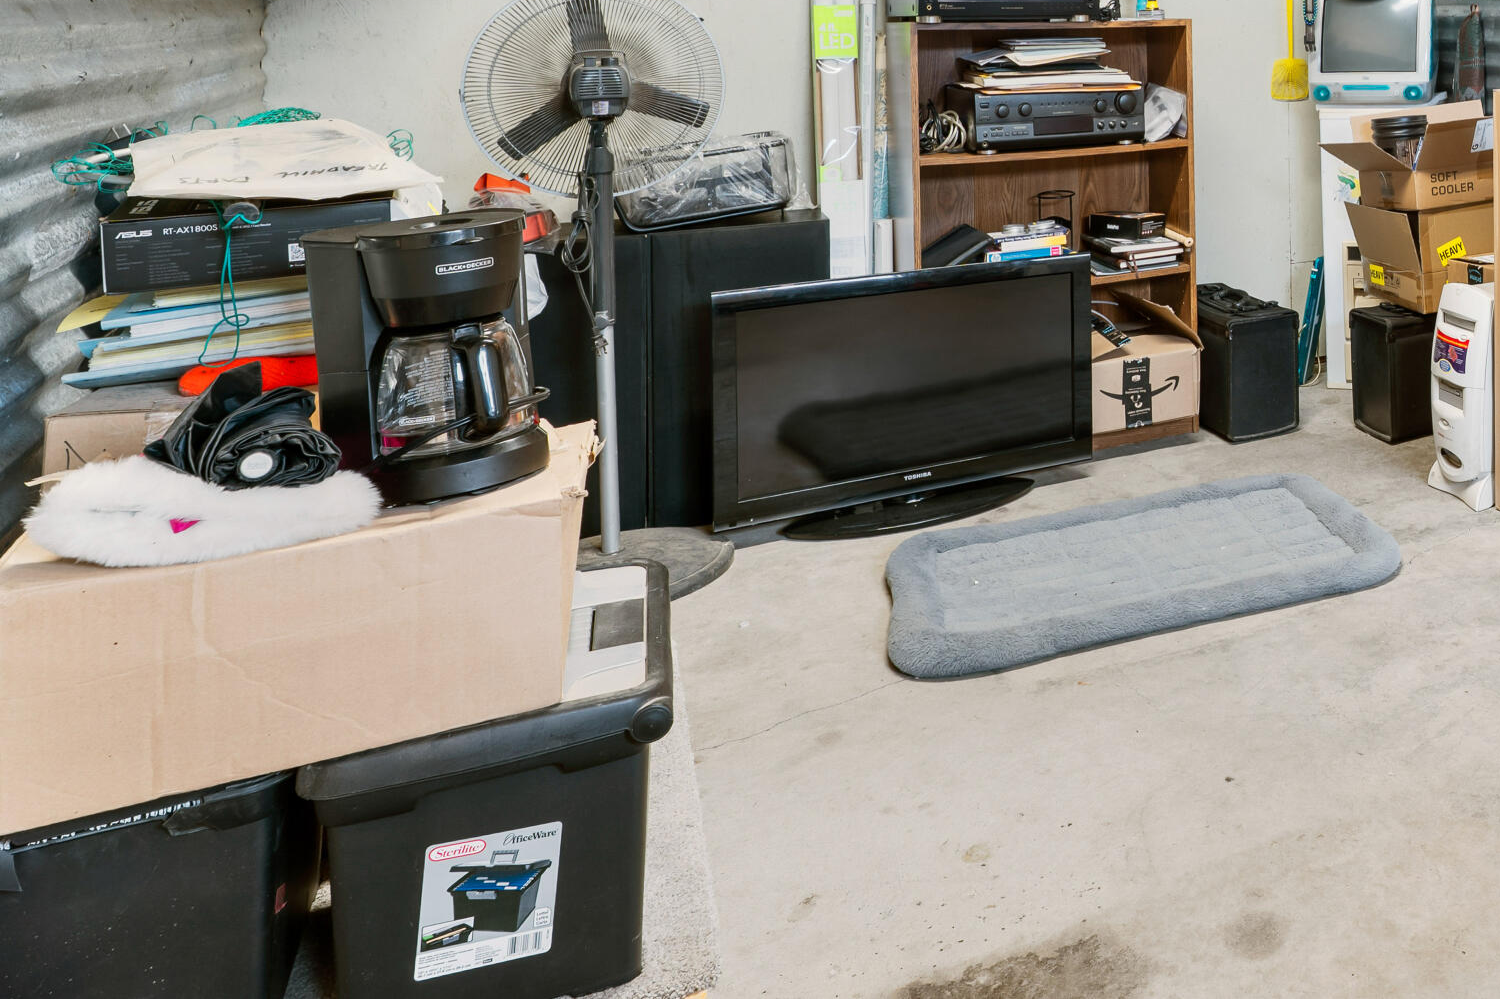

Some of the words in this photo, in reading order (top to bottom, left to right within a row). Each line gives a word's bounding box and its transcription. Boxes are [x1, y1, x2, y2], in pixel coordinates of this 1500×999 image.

[819, 33, 855, 50] LED
[1430, 171, 1457, 183] SOFT
[1432, 182, 1474, 196] COOLER
[114, 229, 153, 240] ASUS
[163, 224, 218, 236] RT-AX1800S
[1439, 241, 1464, 261] HEAVY
[438, 258, 492, 273] BLACK+DECKER
[1370, 269, 1384, 281] HEAVY
[904, 471, 932, 481] TOSHIBA
[503, 830, 557, 846] OfficeWare
[435, 843, 480, 859] Sterilite
